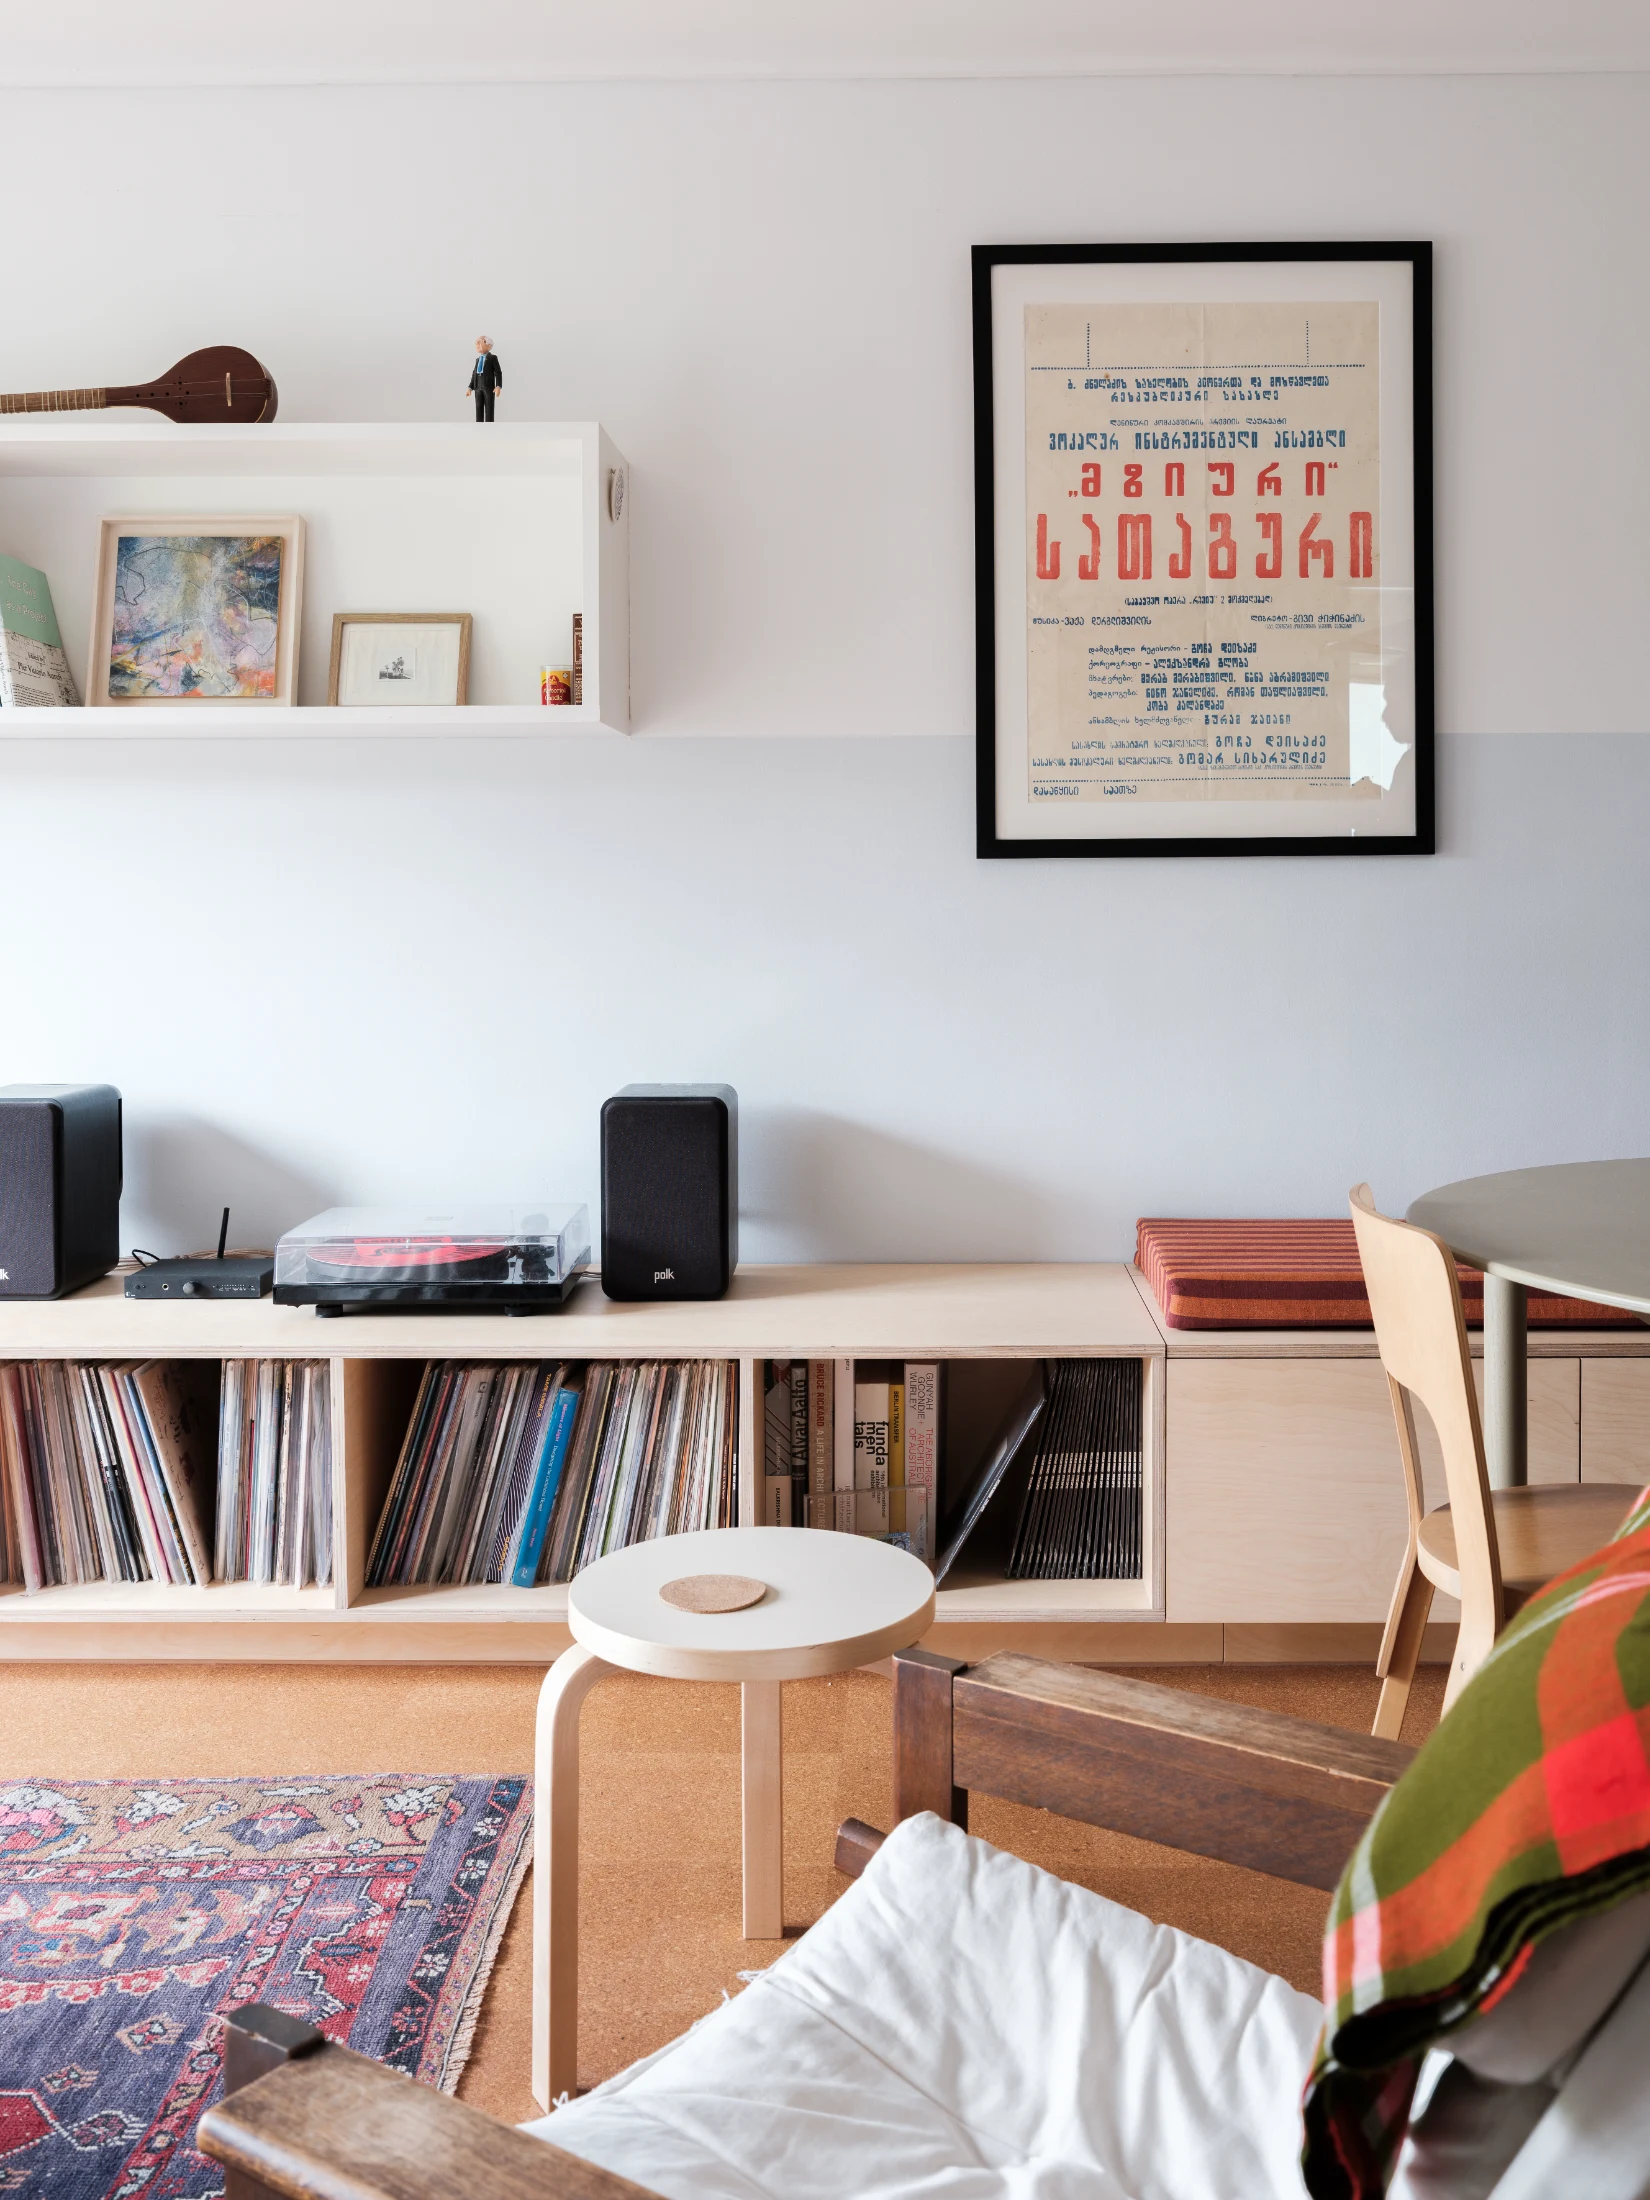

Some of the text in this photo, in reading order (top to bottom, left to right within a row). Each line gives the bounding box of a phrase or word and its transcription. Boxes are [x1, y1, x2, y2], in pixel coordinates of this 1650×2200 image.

[1049, 429, 1346, 451] ვოკალურ ინსტრუმენტული ანსამბლი
[1036, 511, 1373, 580] სათაგური
[654, 1267, 675, 1284] polk
[816, 1363, 825, 1390] BRUCE
[909, 1371, 918, 1411] WURLEY
[925, 1372, 934, 1411] GUNYAH
[816, 1391, 825, 1427] RICKARD
[816, 1437, 824, 1454] LIFE
[855, 1421, 867, 1449] tals
[866, 1421, 876, 1455] men
[875, 1421, 889, 1466] funda
[908, 1427, 917, 1441] OF
[925, 1427, 934, 1447] THE
[816, 1456, 824, 1465] IN
[816, 1467, 826, 1529] ARCHIECTURE
